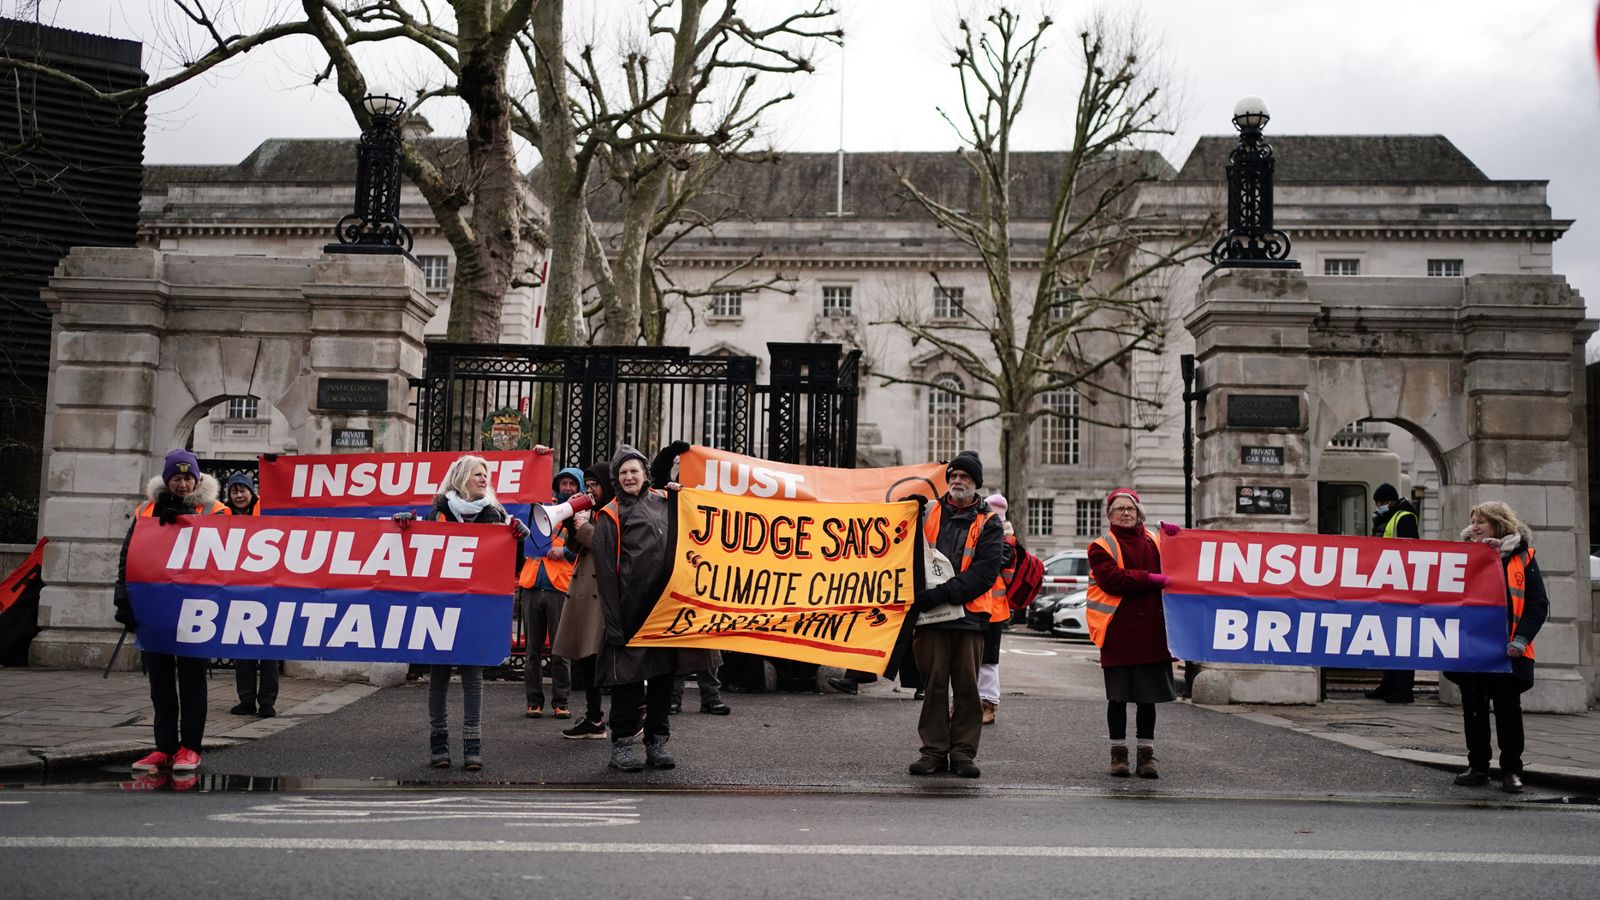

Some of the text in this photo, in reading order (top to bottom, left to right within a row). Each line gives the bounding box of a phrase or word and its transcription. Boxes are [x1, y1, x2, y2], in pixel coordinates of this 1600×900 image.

[341, 431, 366, 439] PRIVATE
[696, 459, 804, 498] JUST
[1245, 455, 1280, 464] CAR PARK
[165, 525, 479, 580] INSULATE
[688, 504, 813, 560] JUDGE
[807, 568, 907, 606] CHANGE
[1197, 541, 1468, 593] INSULATE
[176, 598, 462, 651] BRITAIN
[665, 607, 697, 635] IS
[1212, 608, 1460, 659] BRITAIN
